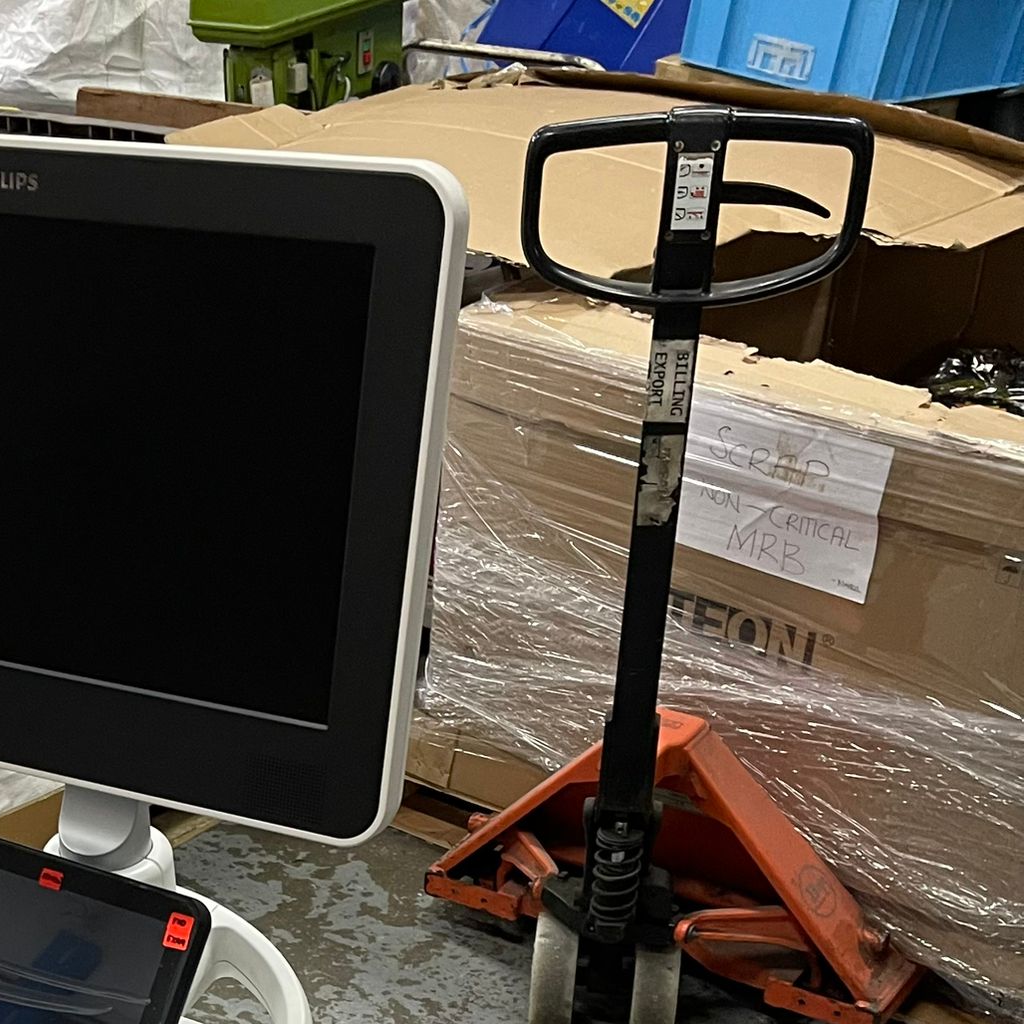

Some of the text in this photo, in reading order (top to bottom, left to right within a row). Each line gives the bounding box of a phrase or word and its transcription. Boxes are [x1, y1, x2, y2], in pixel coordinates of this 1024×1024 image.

[648, 352, 667, 407] EXPORT
[670, 353, 689, 416] BILLING
[709, 425, 830, 487] SCRAP
[726, 524, 805, 576] MRB
